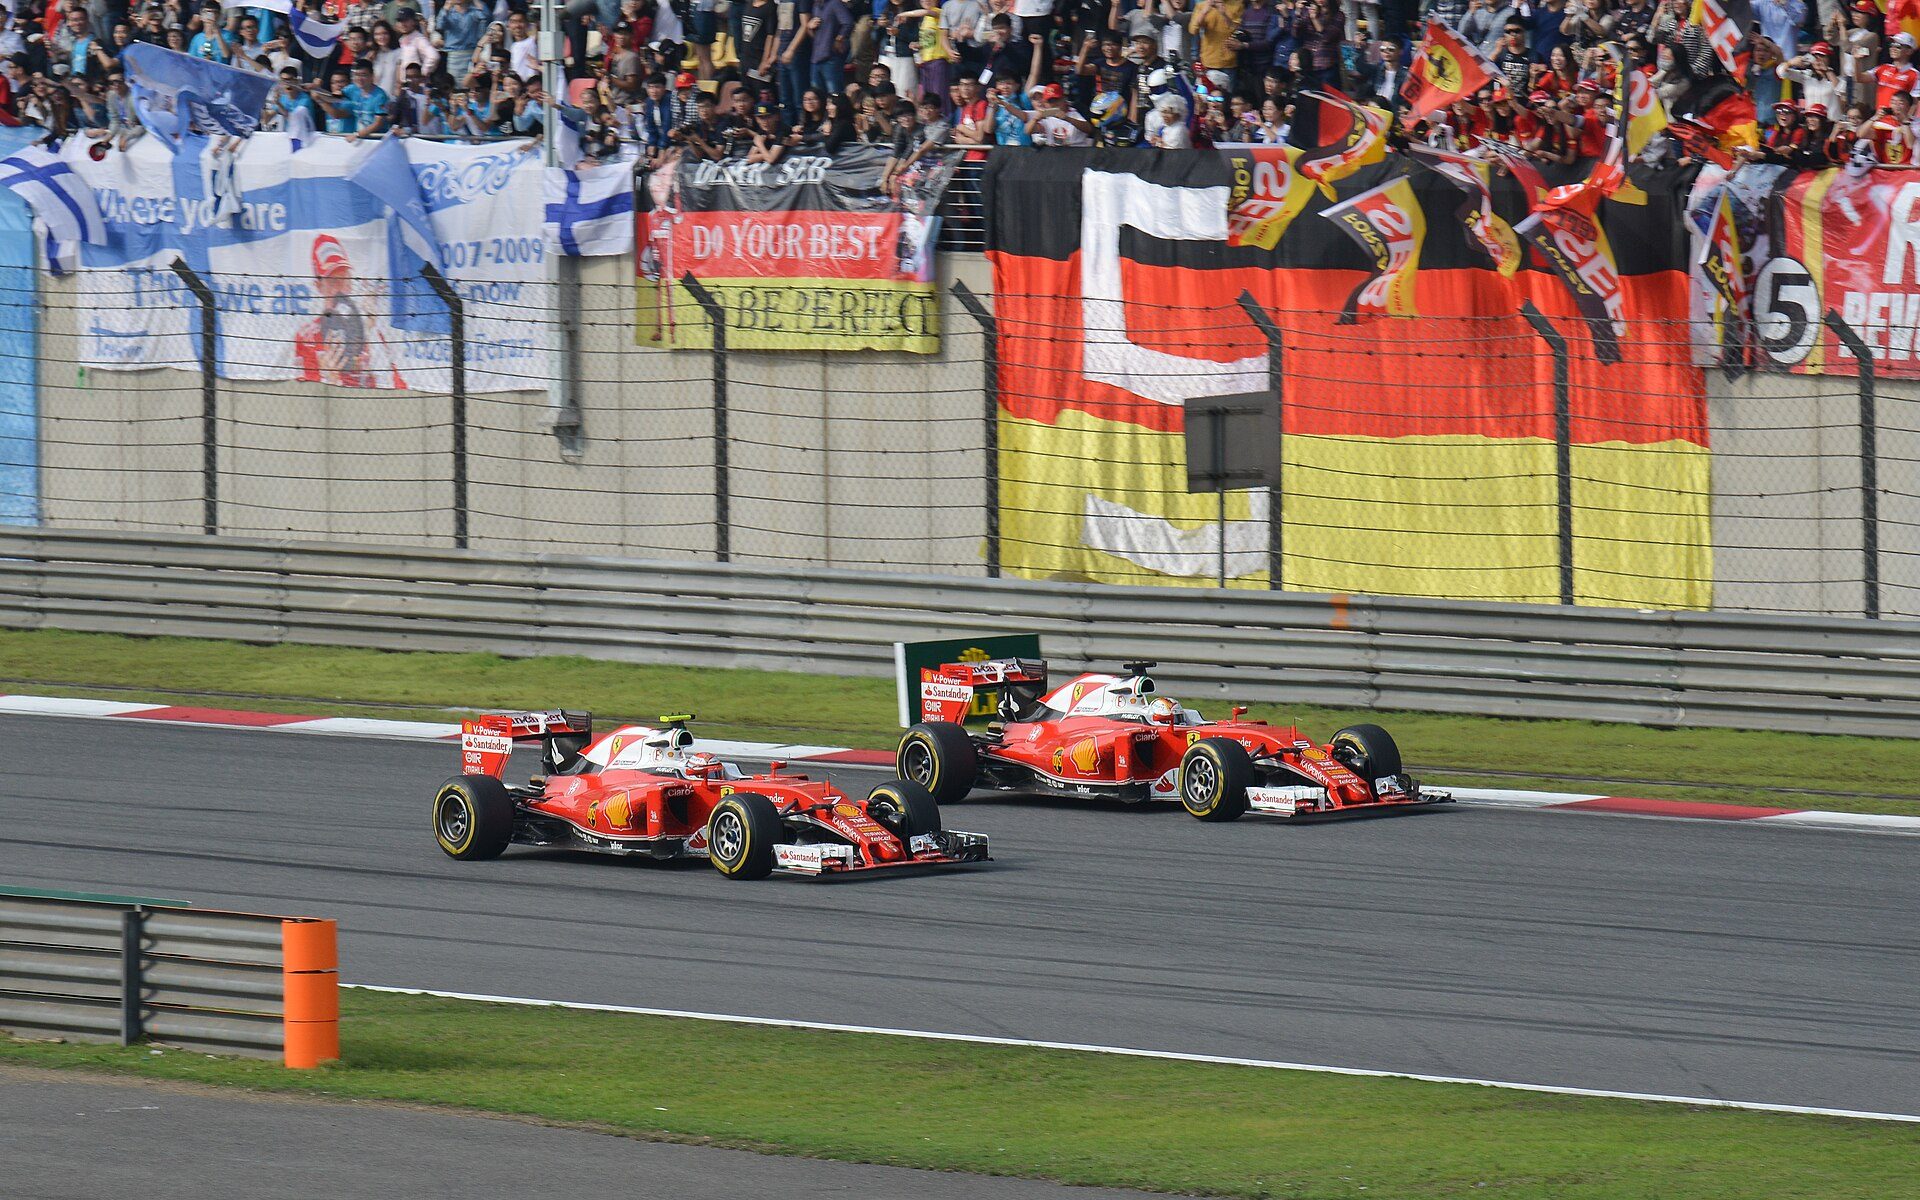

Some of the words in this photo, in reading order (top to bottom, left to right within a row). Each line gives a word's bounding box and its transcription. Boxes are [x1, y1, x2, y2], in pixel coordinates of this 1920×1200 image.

[240, 201, 287, 231] are
[692, 225, 725, 260] DO
[730, 217, 804, 261] YOUR
[808, 223, 885, 261] BEST
[440, 237, 544, 269] 007-2009
[1764, 271, 1812, 353] 5
[932, 673, 961, 685] V-Power
[933, 686, 969, 700] Santander
[473, 725, 501, 736] V-Power
[473, 737, 508, 751] Santander
[1135, 733, 1157, 742] Claro
[667, 787, 692, 797] Claro
[1262, 793, 1293, 805] Santander
[789, 850, 820, 863] Santander
